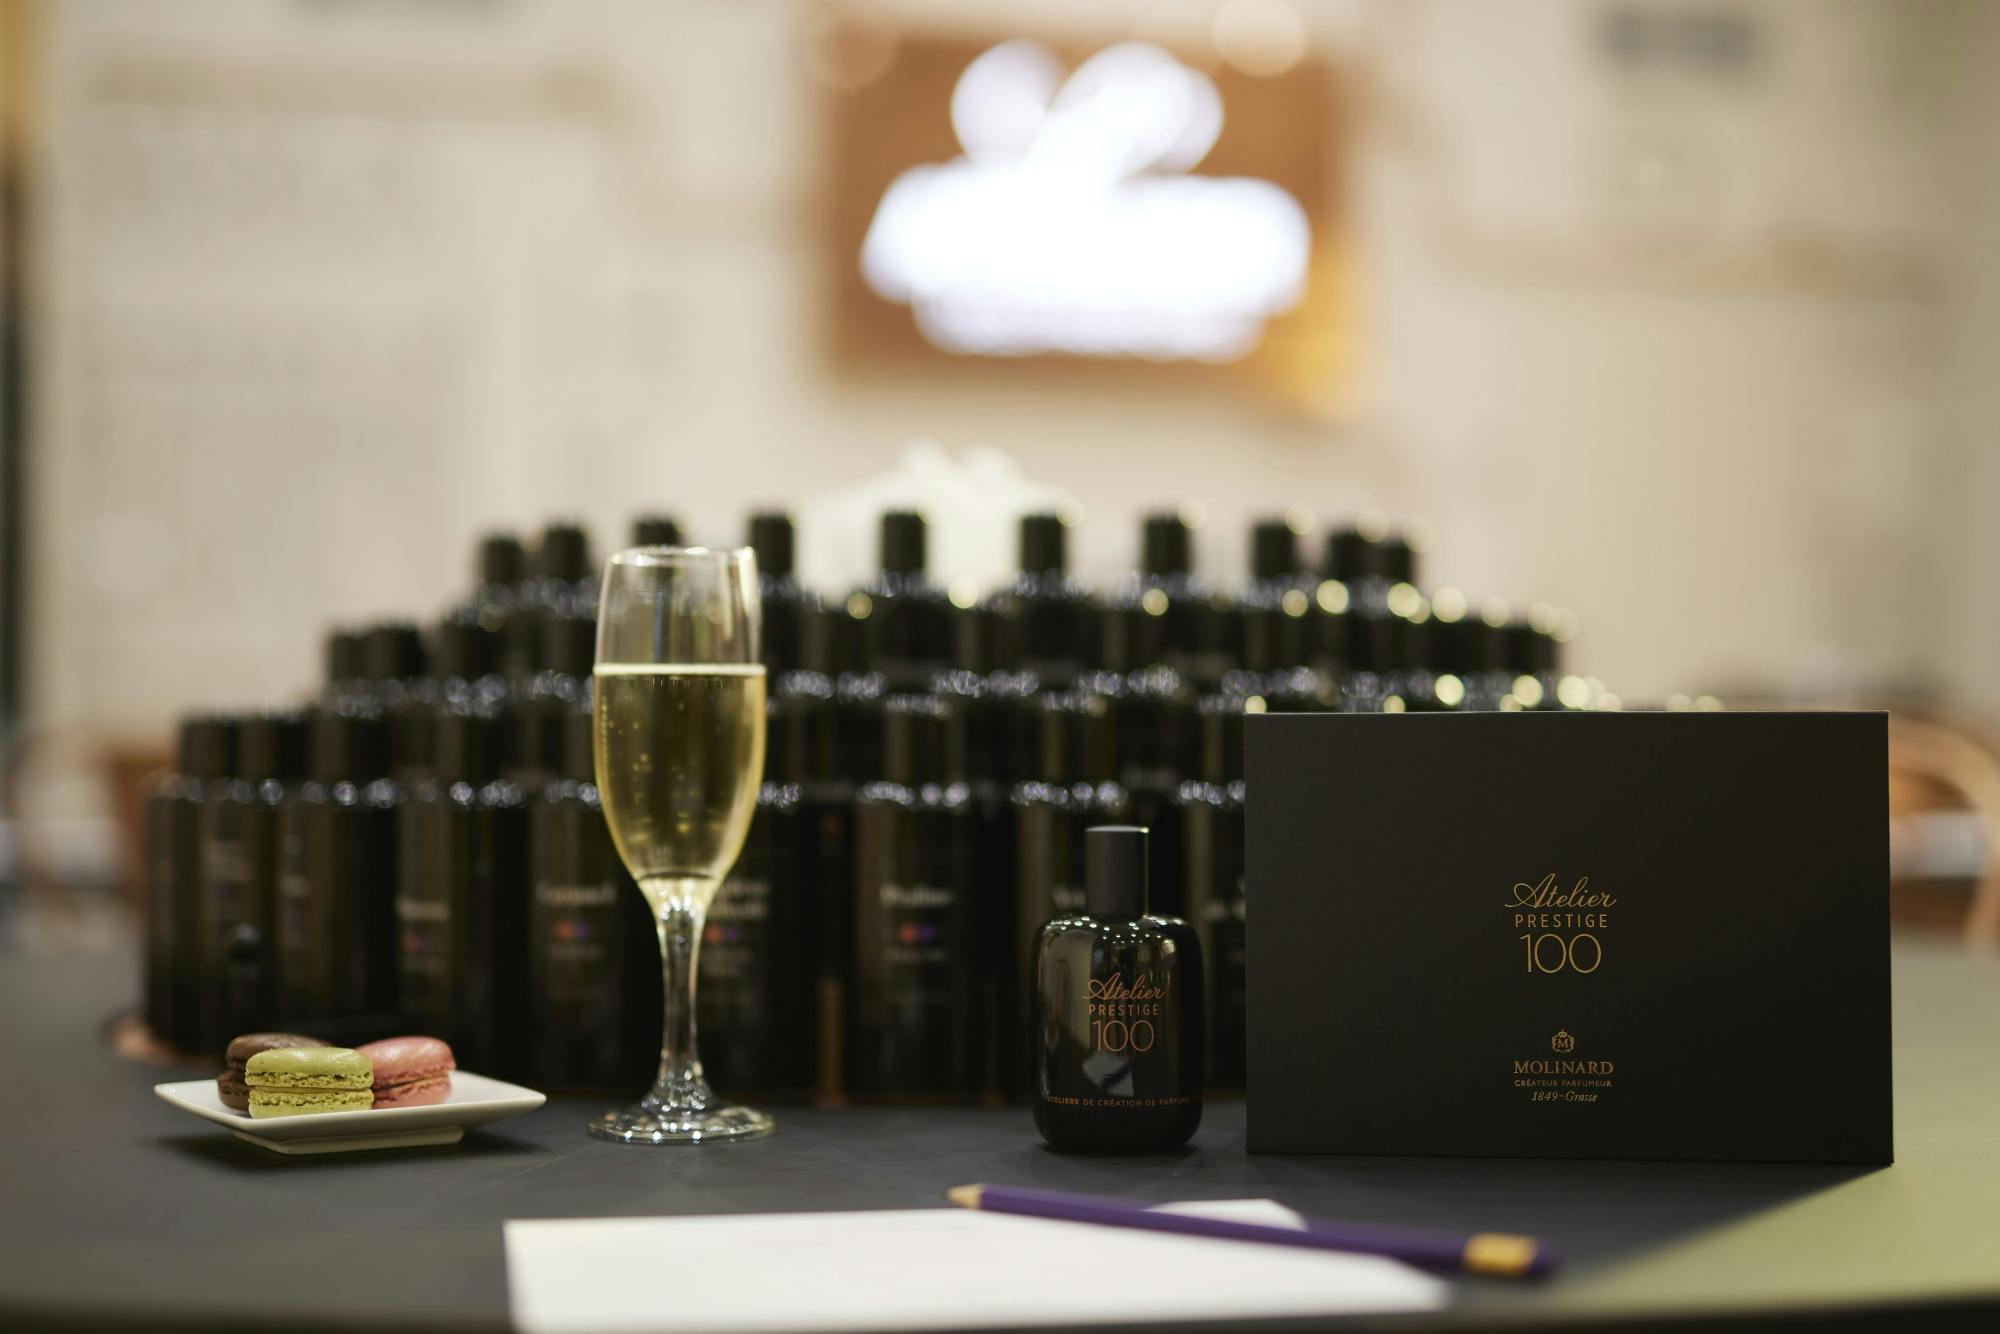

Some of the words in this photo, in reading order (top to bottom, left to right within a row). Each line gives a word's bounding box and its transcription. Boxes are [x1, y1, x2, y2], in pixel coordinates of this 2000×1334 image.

[1504, 873, 1617, 909] Atelier
[1514, 914, 1608, 928] PRESTIGE
[1519, 933, 1602, 973] 100
[1081, 972, 1166, 1000] Atelier
[1088, 1004, 1160, 1016] PRESTIGE
[1092, 1020, 1155, 1052] 100
[1513, 1060, 1614, 1075] MOLINARD
[1561, 1079, 1612, 1087] PARFUMEUR
[1083, 1098, 1094, 1106] DE
[1146, 1098, 1156, 1106] DE
